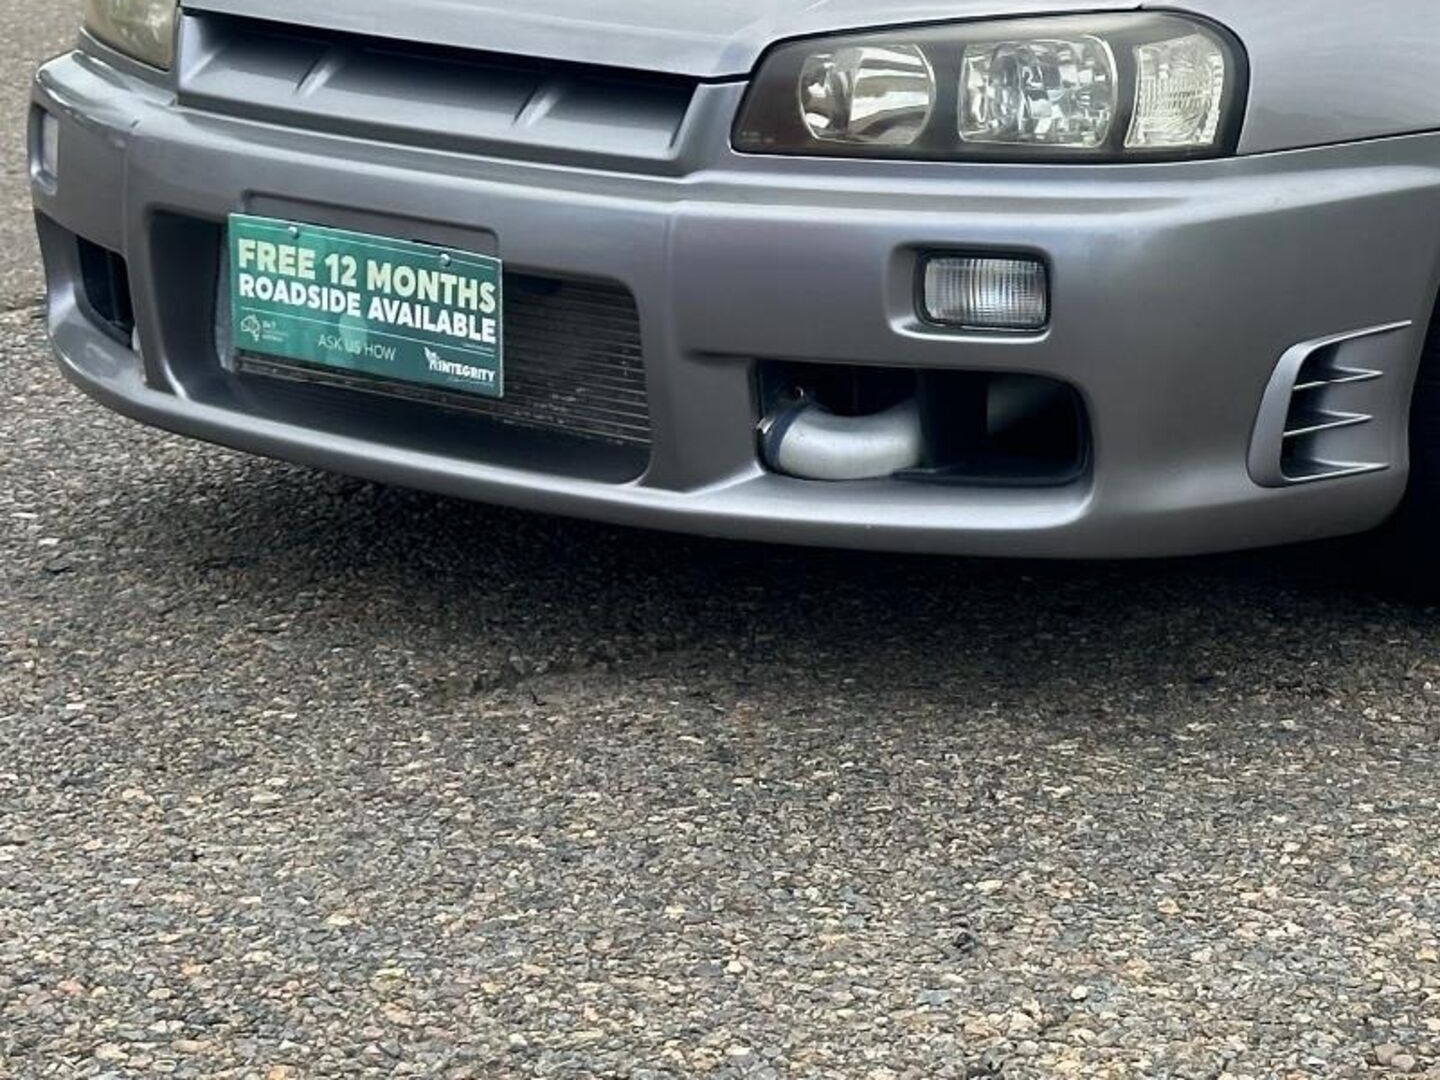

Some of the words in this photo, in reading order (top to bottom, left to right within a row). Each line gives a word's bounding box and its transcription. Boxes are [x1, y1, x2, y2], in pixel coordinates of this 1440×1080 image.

[238, 238, 316, 280] FREE
[325, 253, 357, 287] 12
[366, 260, 496, 313] MONTHS
[238, 273, 361, 317] ROADSIDE
[368, 296, 496, 344] AVAILABLE
[317, 334, 343, 352] ASK
[344, 339, 361, 355] US
[365, 344, 396, 361] HOW
